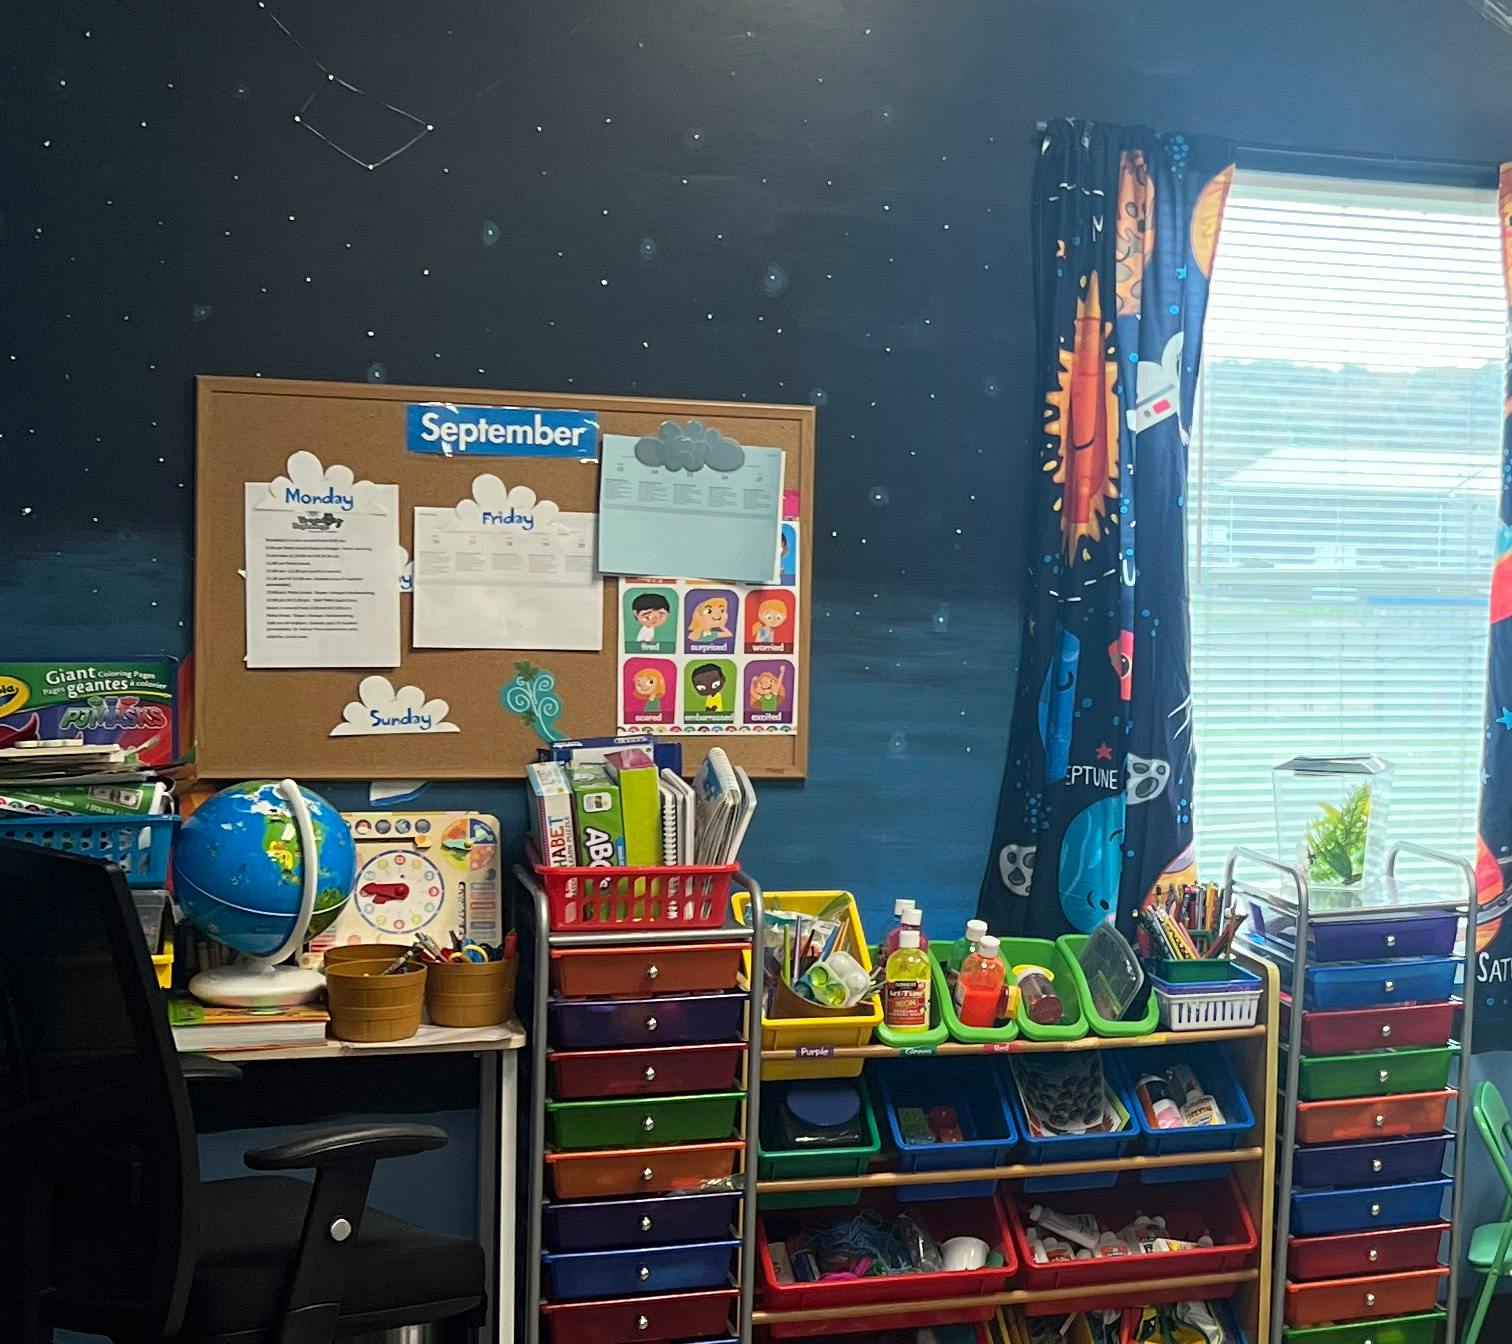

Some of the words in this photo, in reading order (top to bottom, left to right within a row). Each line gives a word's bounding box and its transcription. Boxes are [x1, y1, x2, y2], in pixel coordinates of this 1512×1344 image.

[420, 412, 588, 452] September
[285, 486, 354, 511] Monday
[482, 507, 534, 531] Friday
[641, 642, 660, 651] tired
[690, 643, 728, 654] surprised
[752, 643, 785, 652] worried
[45, 667, 96, 685] Giant
[370, 707, 432, 731] Sunday
[635, 714, 663, 723] scared
[750, 712, 782, 722] excited
[1065, 765, 1119, 790] EPTUNE
[547, 816, 567, 868] HABET
[800, 1047, 829, 1057] Purple
